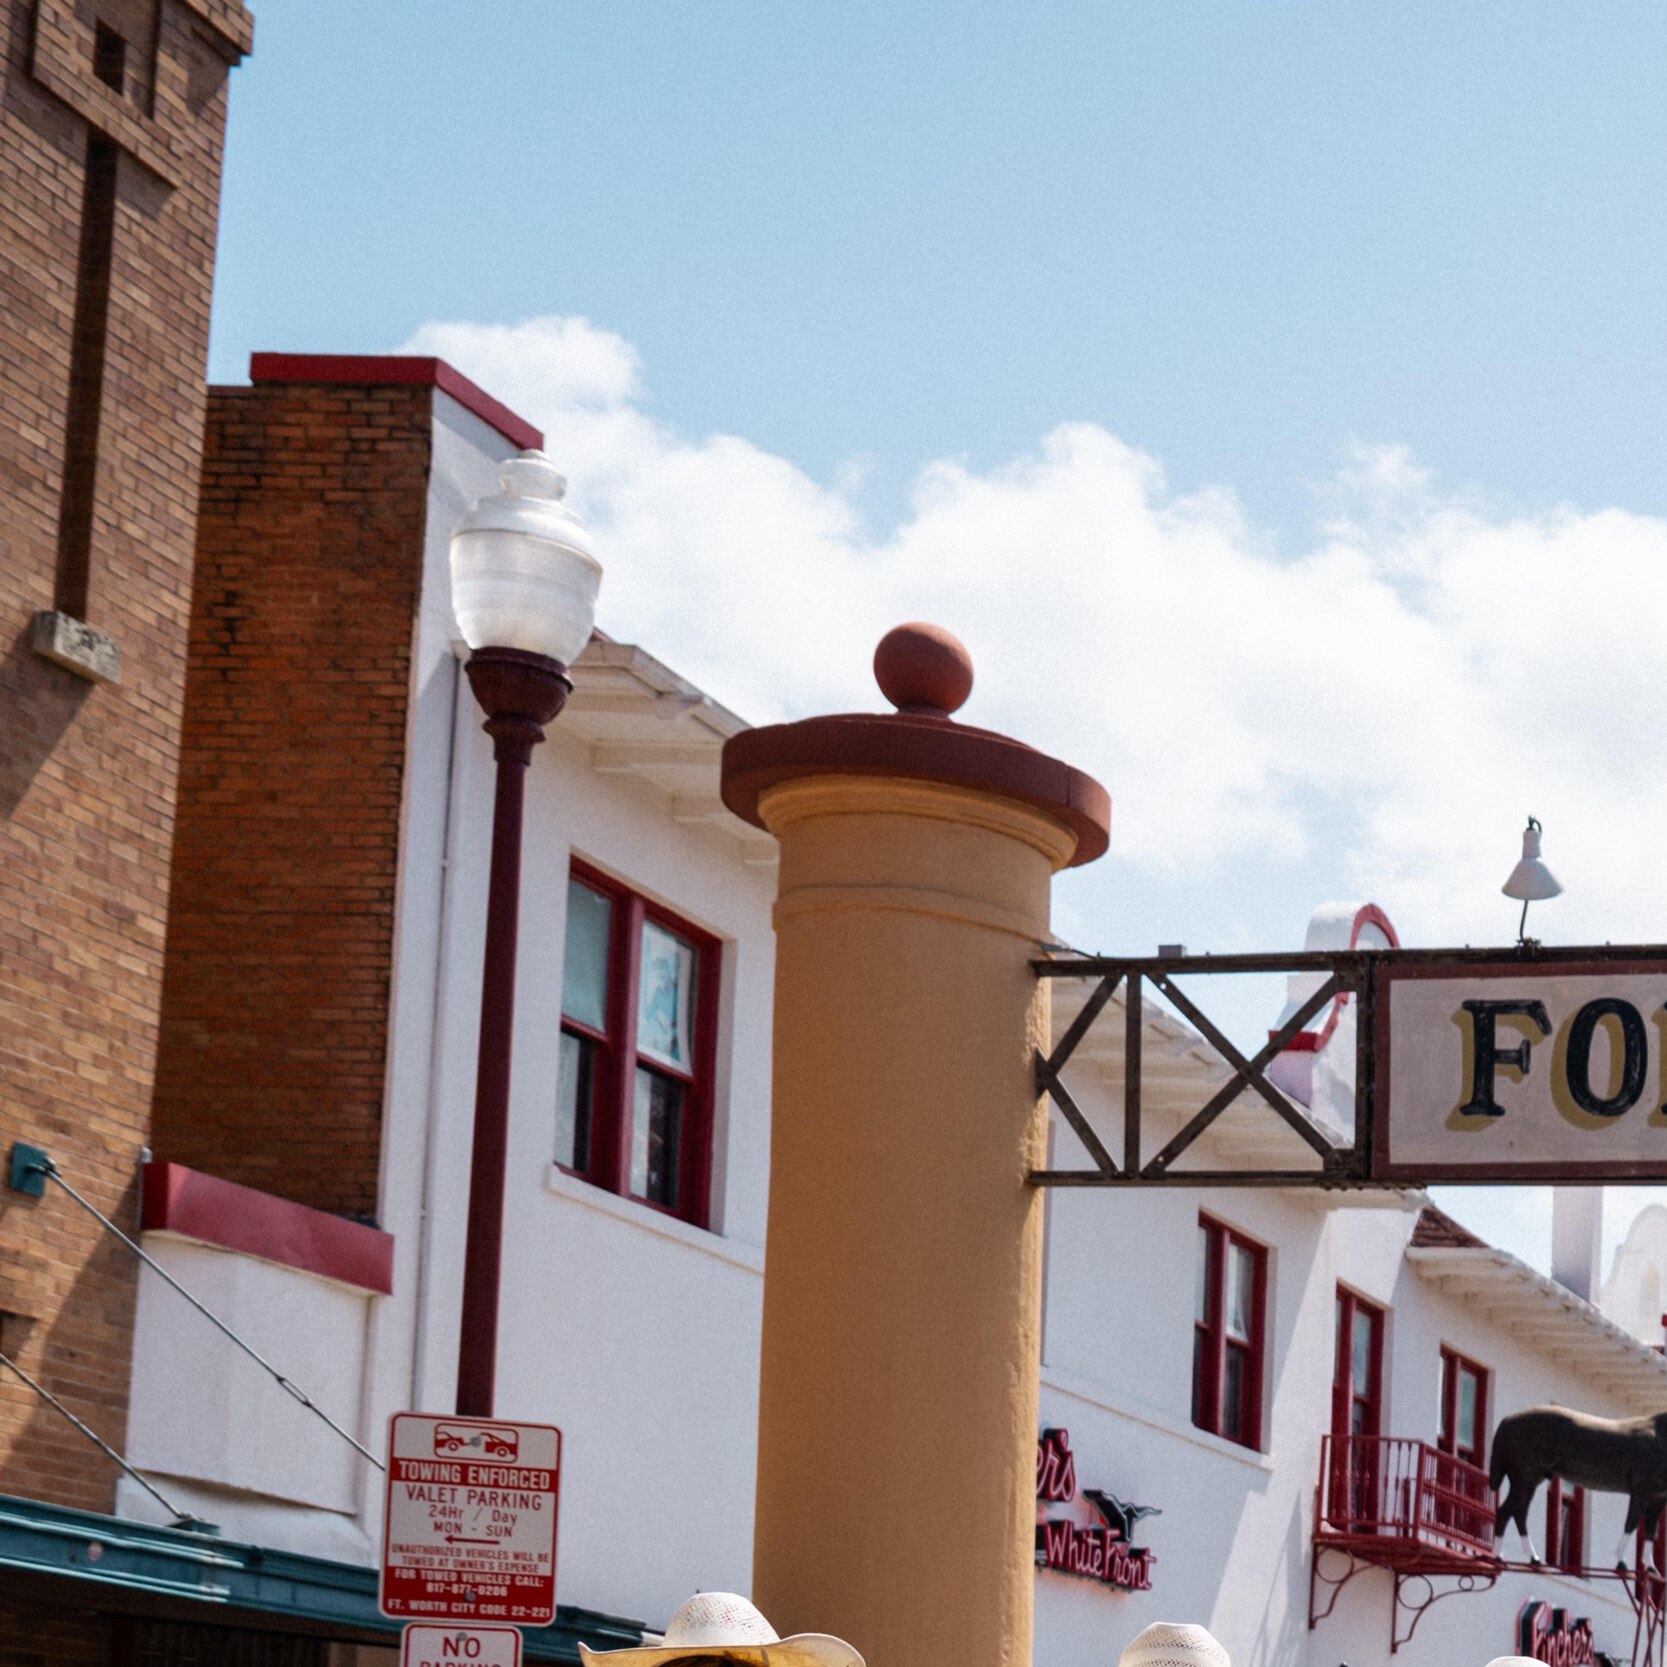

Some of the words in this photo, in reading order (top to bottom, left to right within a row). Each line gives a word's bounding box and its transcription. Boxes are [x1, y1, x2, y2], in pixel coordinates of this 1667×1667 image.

[399, 1461, 461, 1483] TOWING
[468, 1466, 550, 1489] ENFORCED
[406, 1485, 458, 1504] VALET
[468, 1490, 542, 1510] PARKING
[429, 1505, 464, 1519] 24Hr
[492, 1510, 517, 1525] Day
[434, 1522, 462, 1534] MON
[486, 1526, 512, 1537] SUN
[392, 1544, 461, 1557] UNAUTHORIZED
[466, 1548, 509, 1560] VEHICLES
[514, 1552, 534, 1561] WILL
[537, 1553, 549, 1562] BE
[403, 1556, 434, 1567] TOWED
[439, 1558, 449, 1567] AT
[499, 1562, 539, 1572] EXPENSE
[395, 1569, 416, 1579] FOR
[421, 1570, 457, 1581] TOWED
[462, 1573, 511, 1585] VEHICLES
[409, 1600, 447, 1612] WORTH
[451, 1602, 475, 1613] CITY
[480, 1604, 506, 1615] CODE
[443, 1637, 481, 1657] NO
